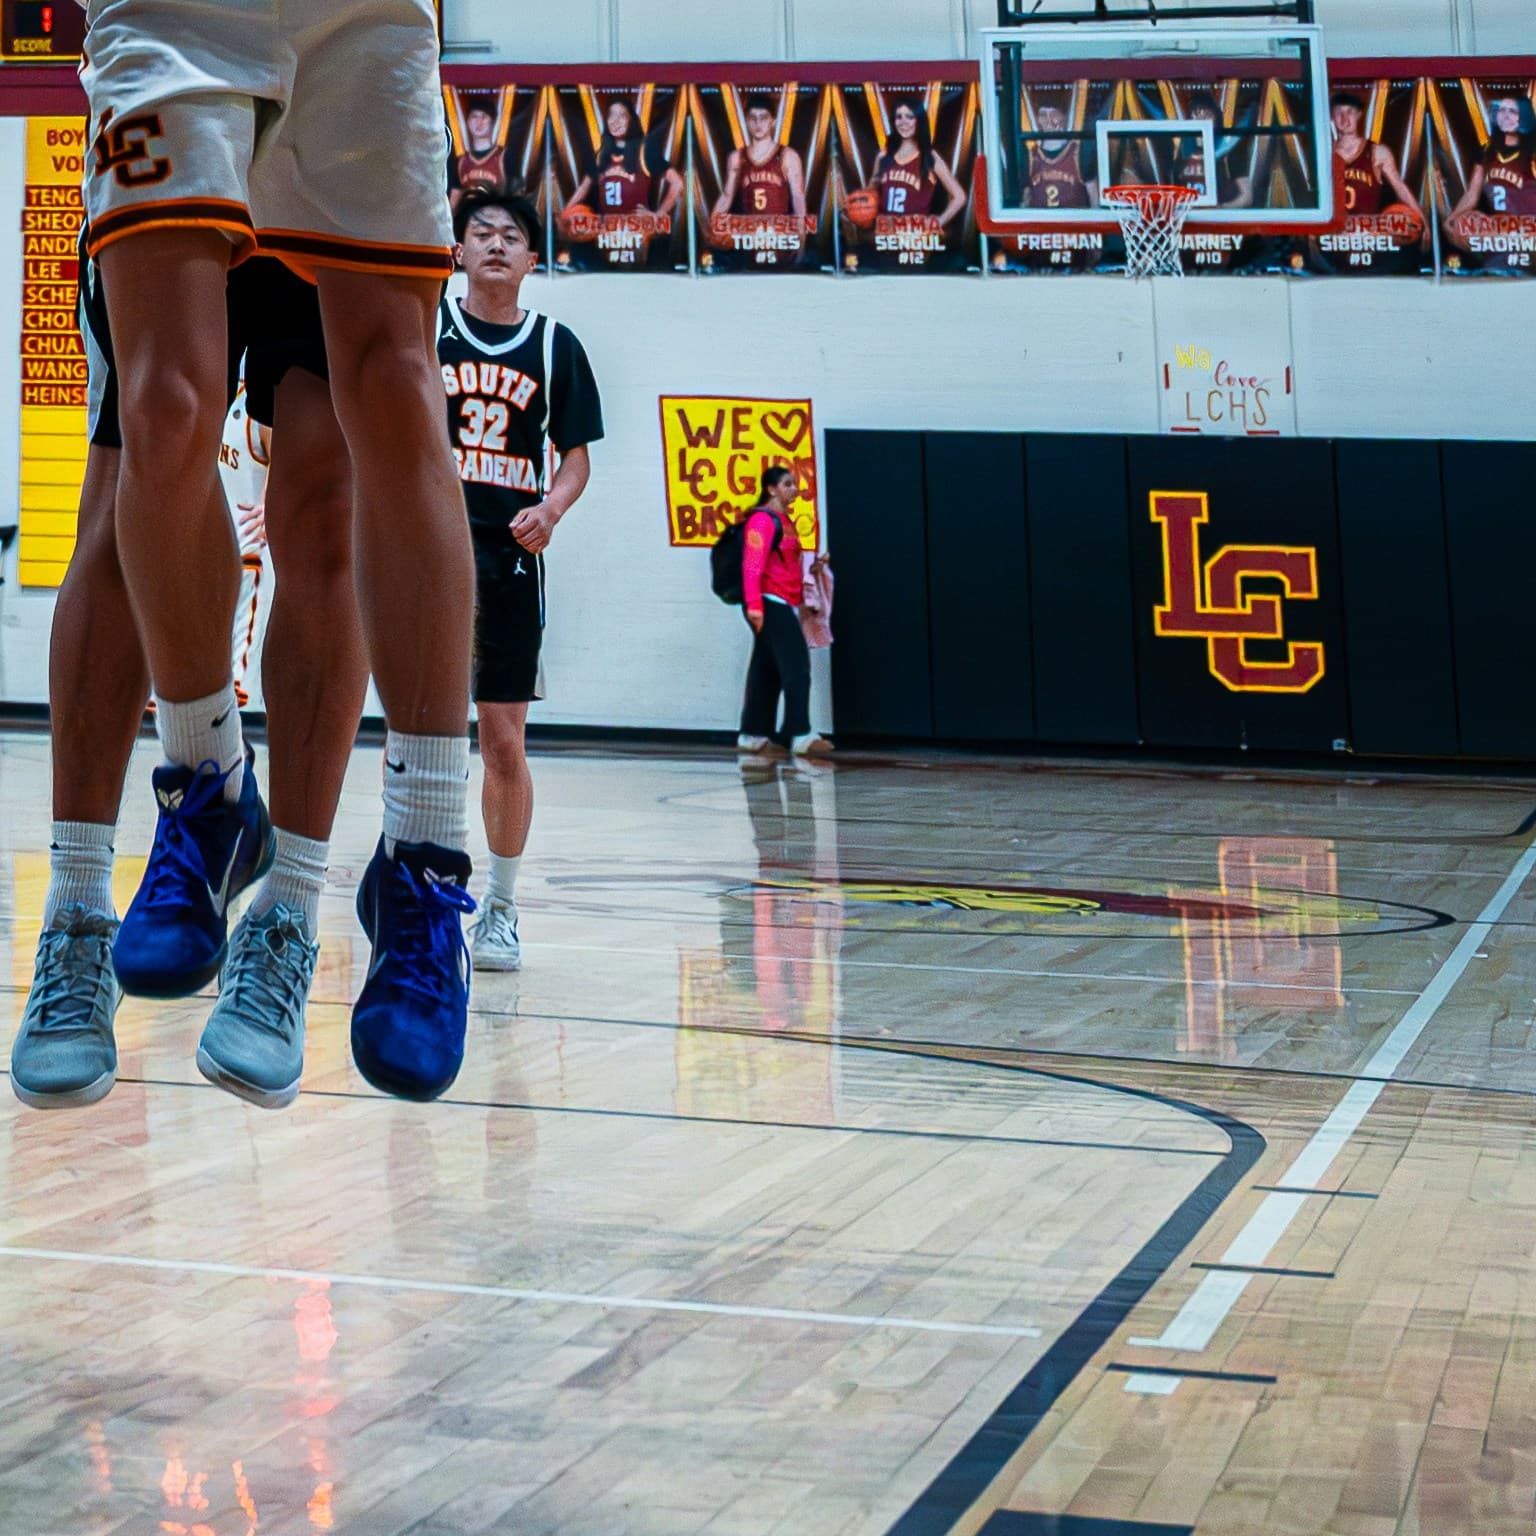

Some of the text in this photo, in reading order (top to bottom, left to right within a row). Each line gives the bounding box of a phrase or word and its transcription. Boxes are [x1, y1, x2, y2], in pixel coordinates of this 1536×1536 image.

[29, 189, 80, 205] TENG
[605, 181, 623, 206] 21
[754, 188, 767, 211] 5
[887, 186, 907, 213] 12
[1046, 186, 1060, 207] 2
[1493, 185, 1507, 211] 2
[598, 231, 643, 249] HUNT
[731, 232, 800, 250] TORRES
[1017, 234, 1103, 251] FREEMAN
[1319, 234, 1400, 252] SIBBREL
[28, 262, 61, 279] LEE
[24, 336, 79, 353] CHUA
[26, 361, 87, 378] WANG
[441, 361, 539, 412] SOUTH
[1186, 388, 1270, 429] LCHS
[458, 397, 509, 451] 32
[677, 407, 755, 450] WE
[679, 448, 718, 503] LC
[1148, 490, 1325, 694] LC
